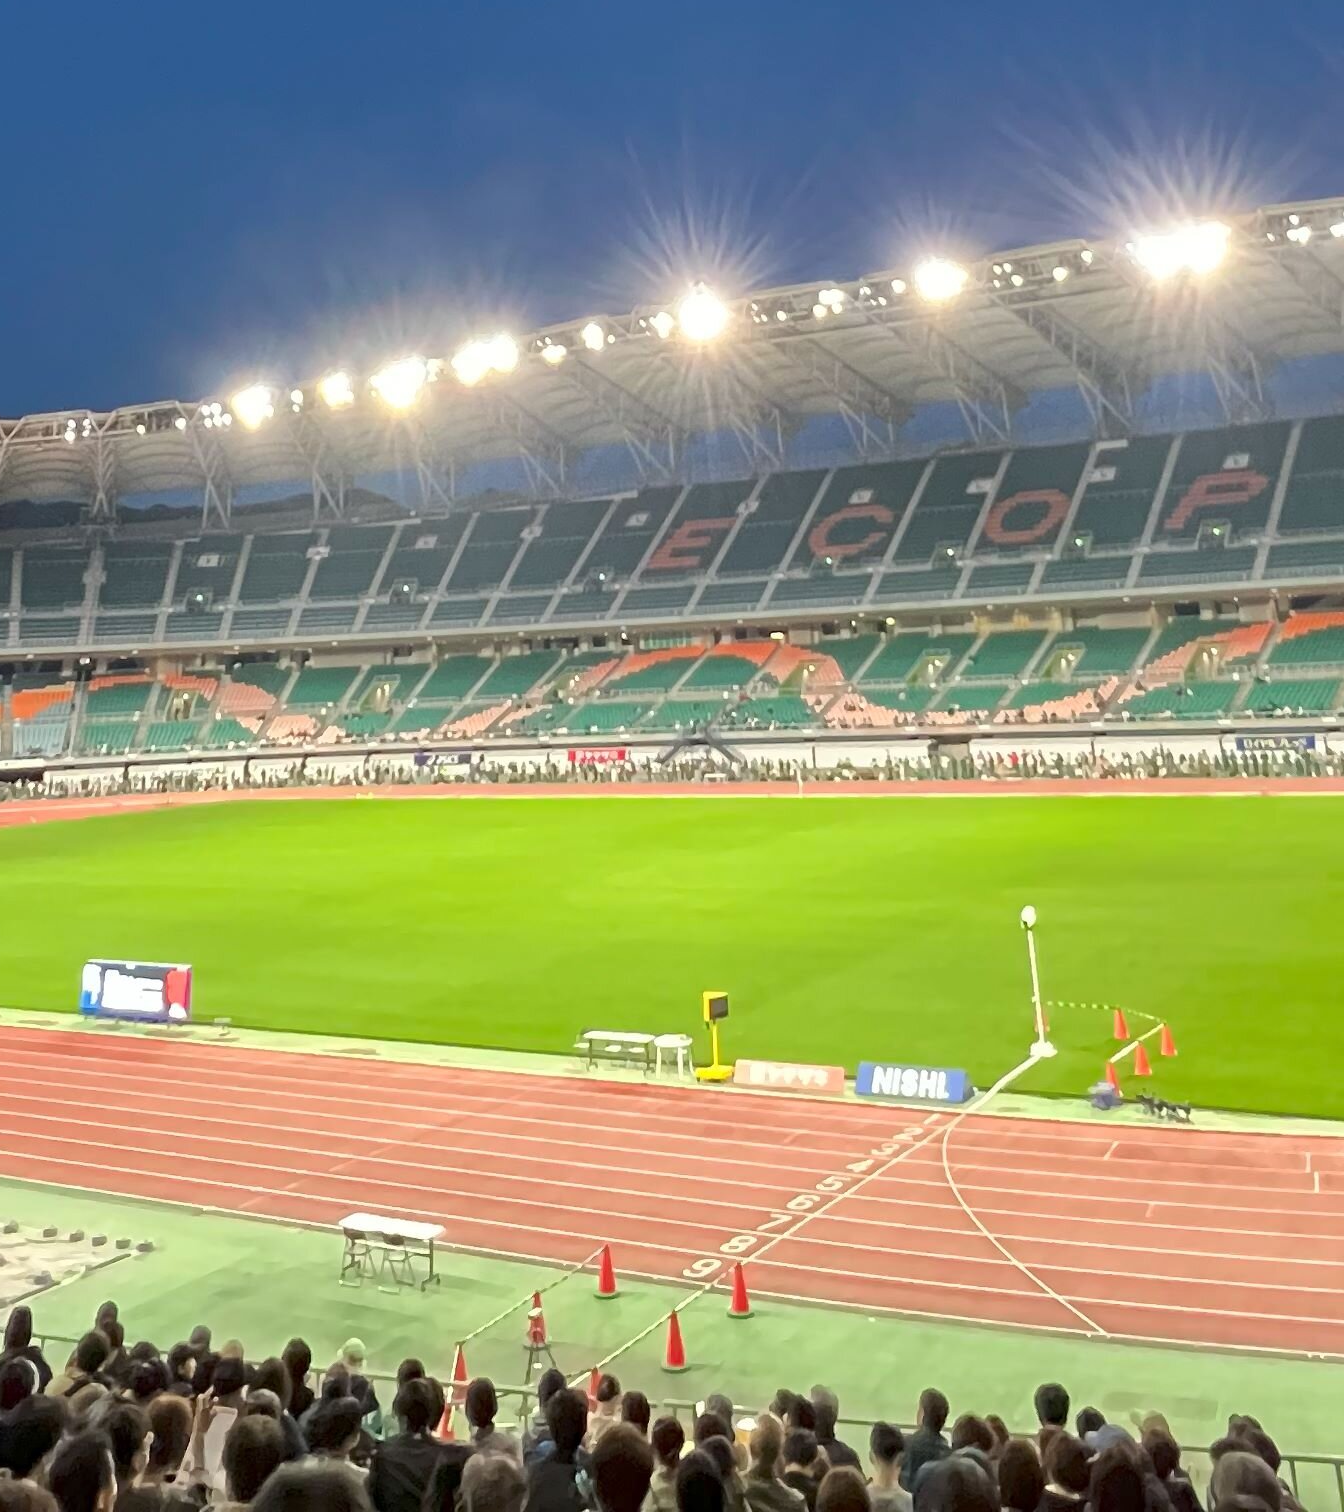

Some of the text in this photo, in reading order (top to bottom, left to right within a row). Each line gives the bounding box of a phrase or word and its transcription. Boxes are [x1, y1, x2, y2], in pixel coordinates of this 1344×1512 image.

[815, 1175, 851, 1191] 5
[786, 1194, 821, 1210] 6
[756, 1213, 793, 1231] 7
[719, 1235, 758, 1253] 8
[682, 1258, 723, 1278] 9
